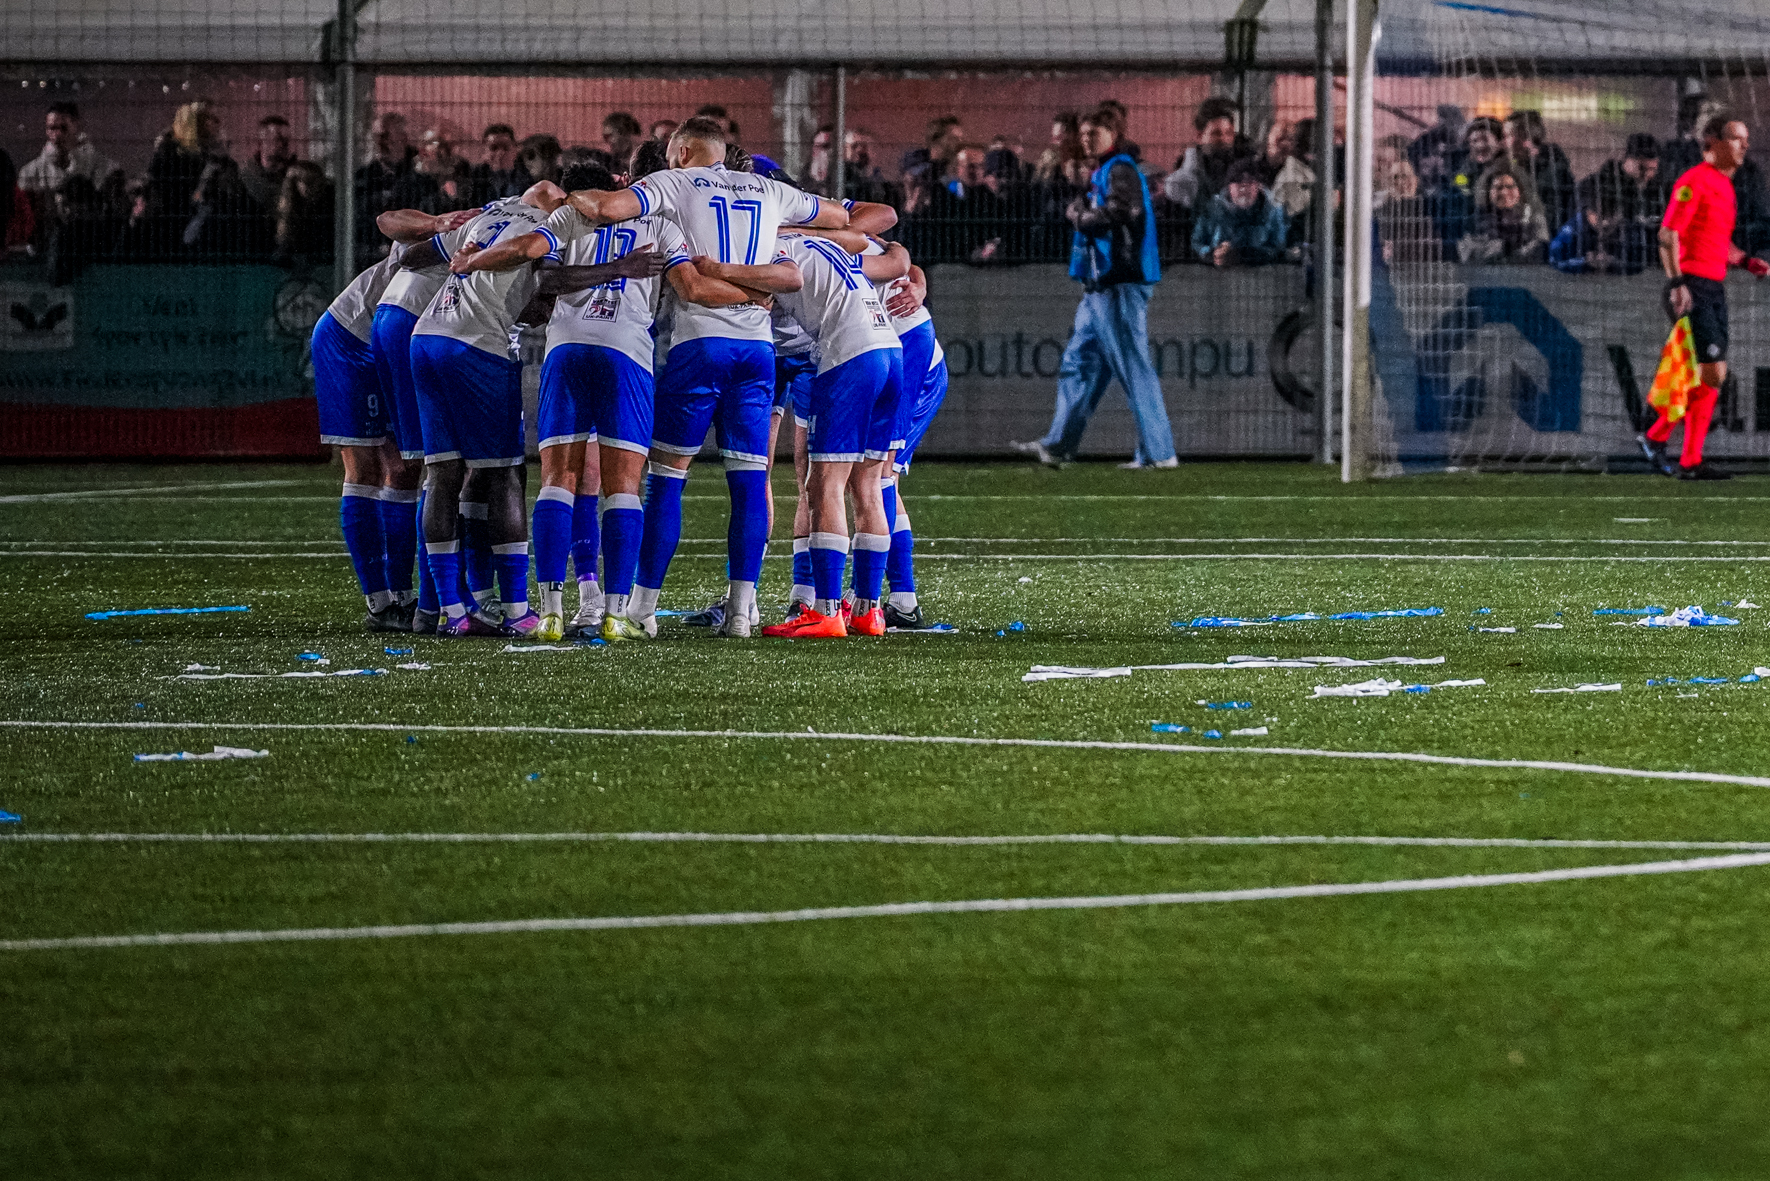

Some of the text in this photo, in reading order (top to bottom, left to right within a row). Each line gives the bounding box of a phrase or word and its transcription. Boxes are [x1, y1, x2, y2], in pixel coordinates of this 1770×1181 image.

[711, 180, 731, 191] Van
[748, 183, 765, 194] Poe
[709, 196, 761, 266] 17
[946, 331, 1254, 385] outompu
[367, 393, 379, 418] 9
